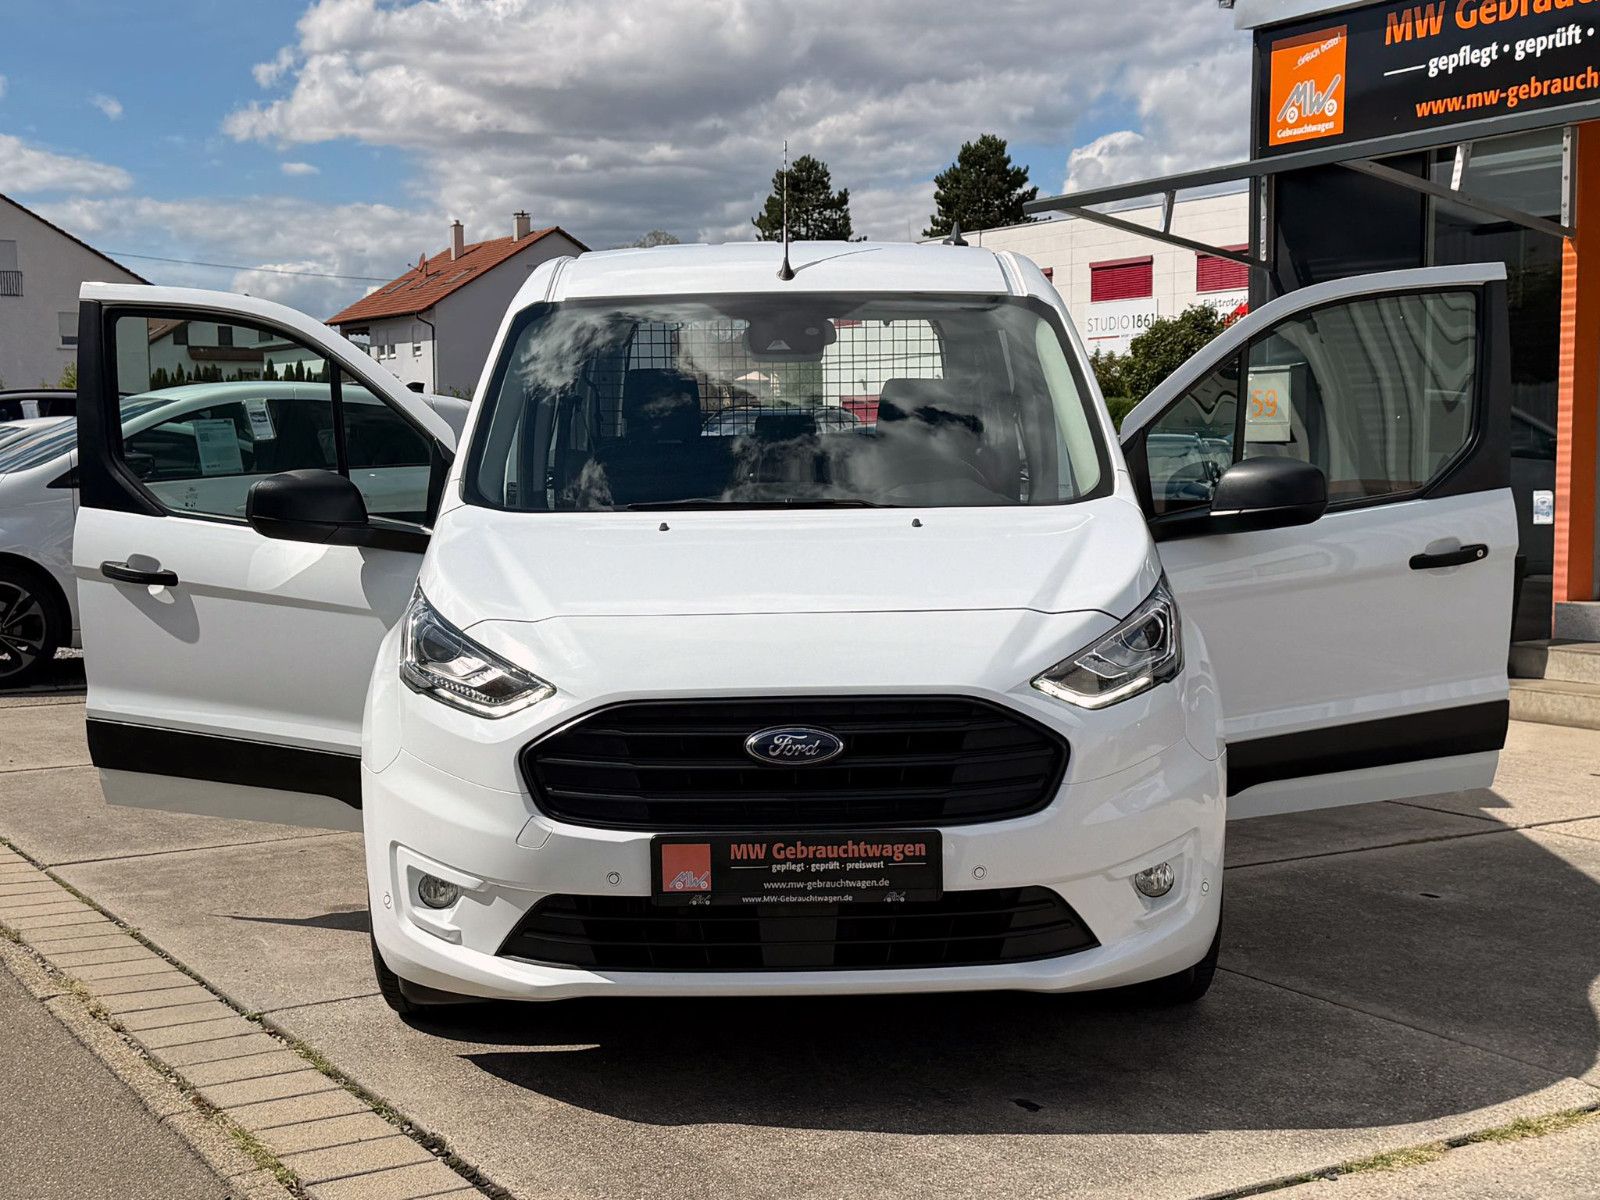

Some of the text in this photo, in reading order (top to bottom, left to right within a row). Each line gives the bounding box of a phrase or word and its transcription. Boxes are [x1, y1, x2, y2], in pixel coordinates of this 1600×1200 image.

[1385, 1, 1446, 46] MW
[1428, 23, 1582, 78] gepflegt geprüft
[1415, 66, 1600, 118] www.mw-gebrauch
[768, 734, 821, 757] Ford
[730, 840, 927, 862] MW Gebrauchtwagen
[771, 860, 885, 873] gepflegt geprüft preiswert
[763, 878, 890, 891] www.mw-gebrauchtwagen.de
[742, 893, 854, 904] www.MW-Gebrauchtwagen.de
